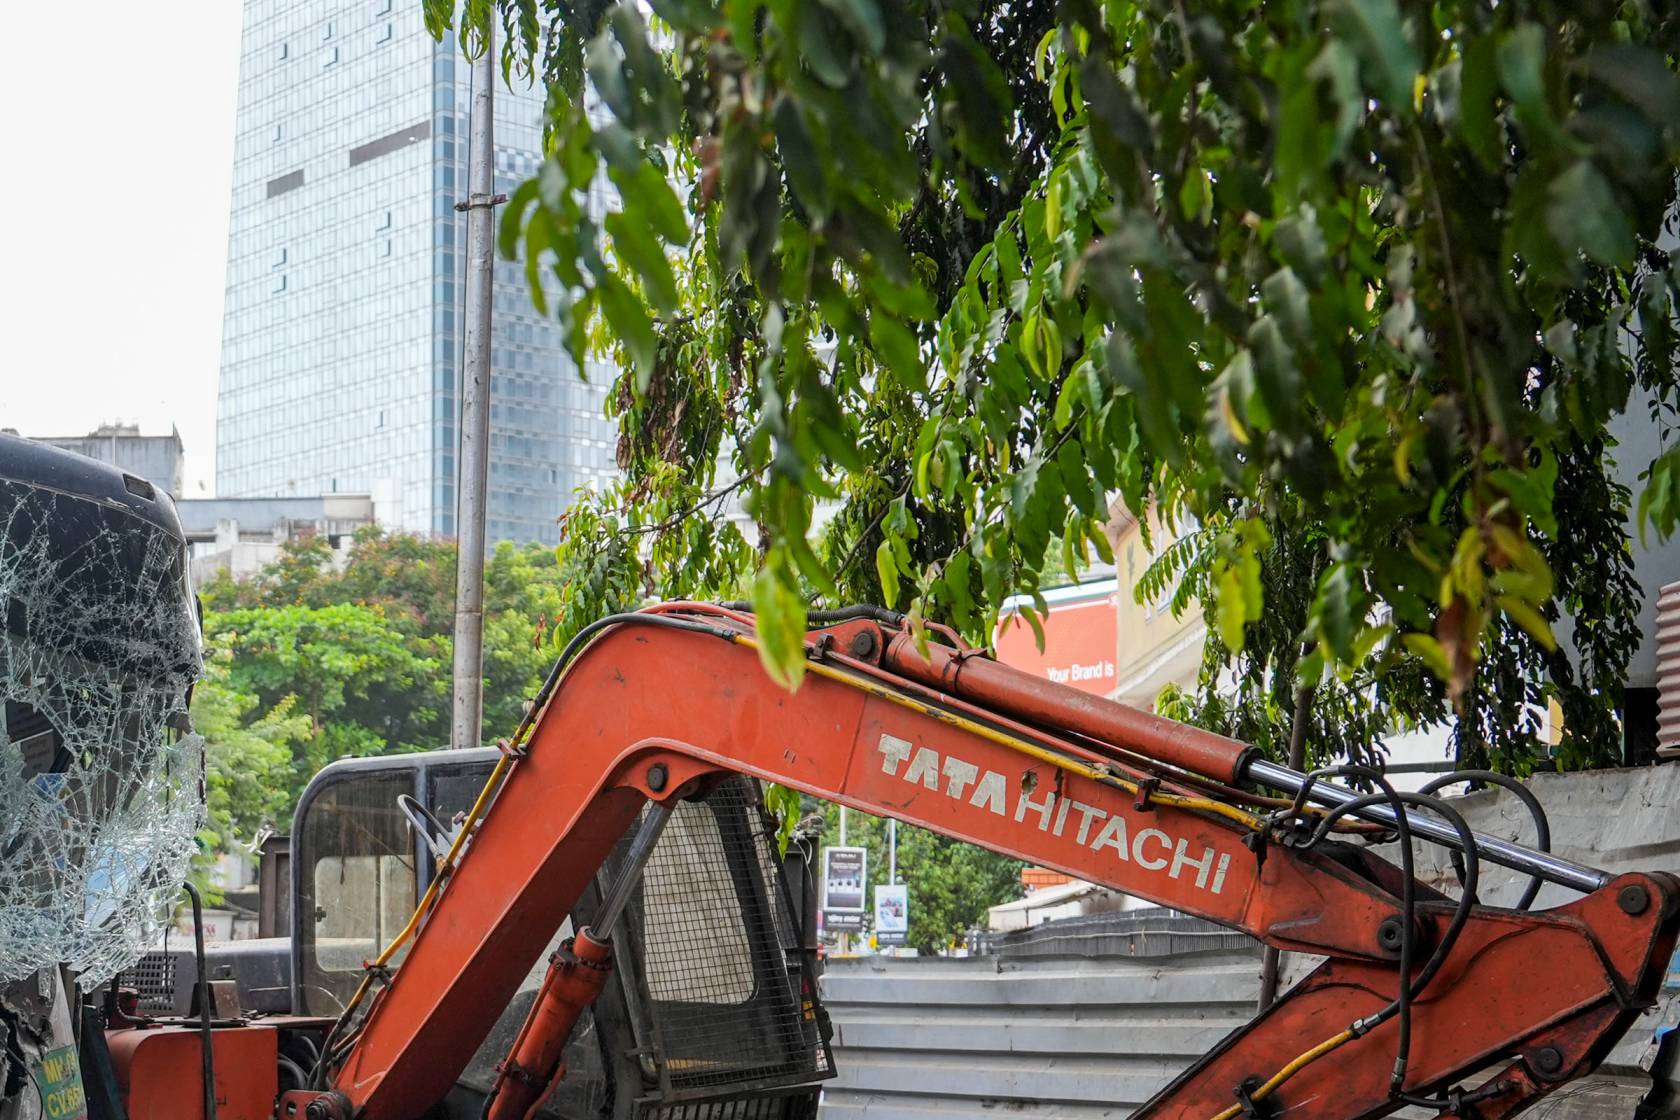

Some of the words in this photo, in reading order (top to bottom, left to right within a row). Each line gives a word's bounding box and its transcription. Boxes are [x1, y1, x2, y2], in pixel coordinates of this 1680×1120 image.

[1047, 667, 1070, 682] Your
[1072, 662, 1102, 680] Brand
[1104, 661, 1115, 677] is
[877, 732, 1008, 815] TATA
[1014, 789, 1232, 895] HITACHI
